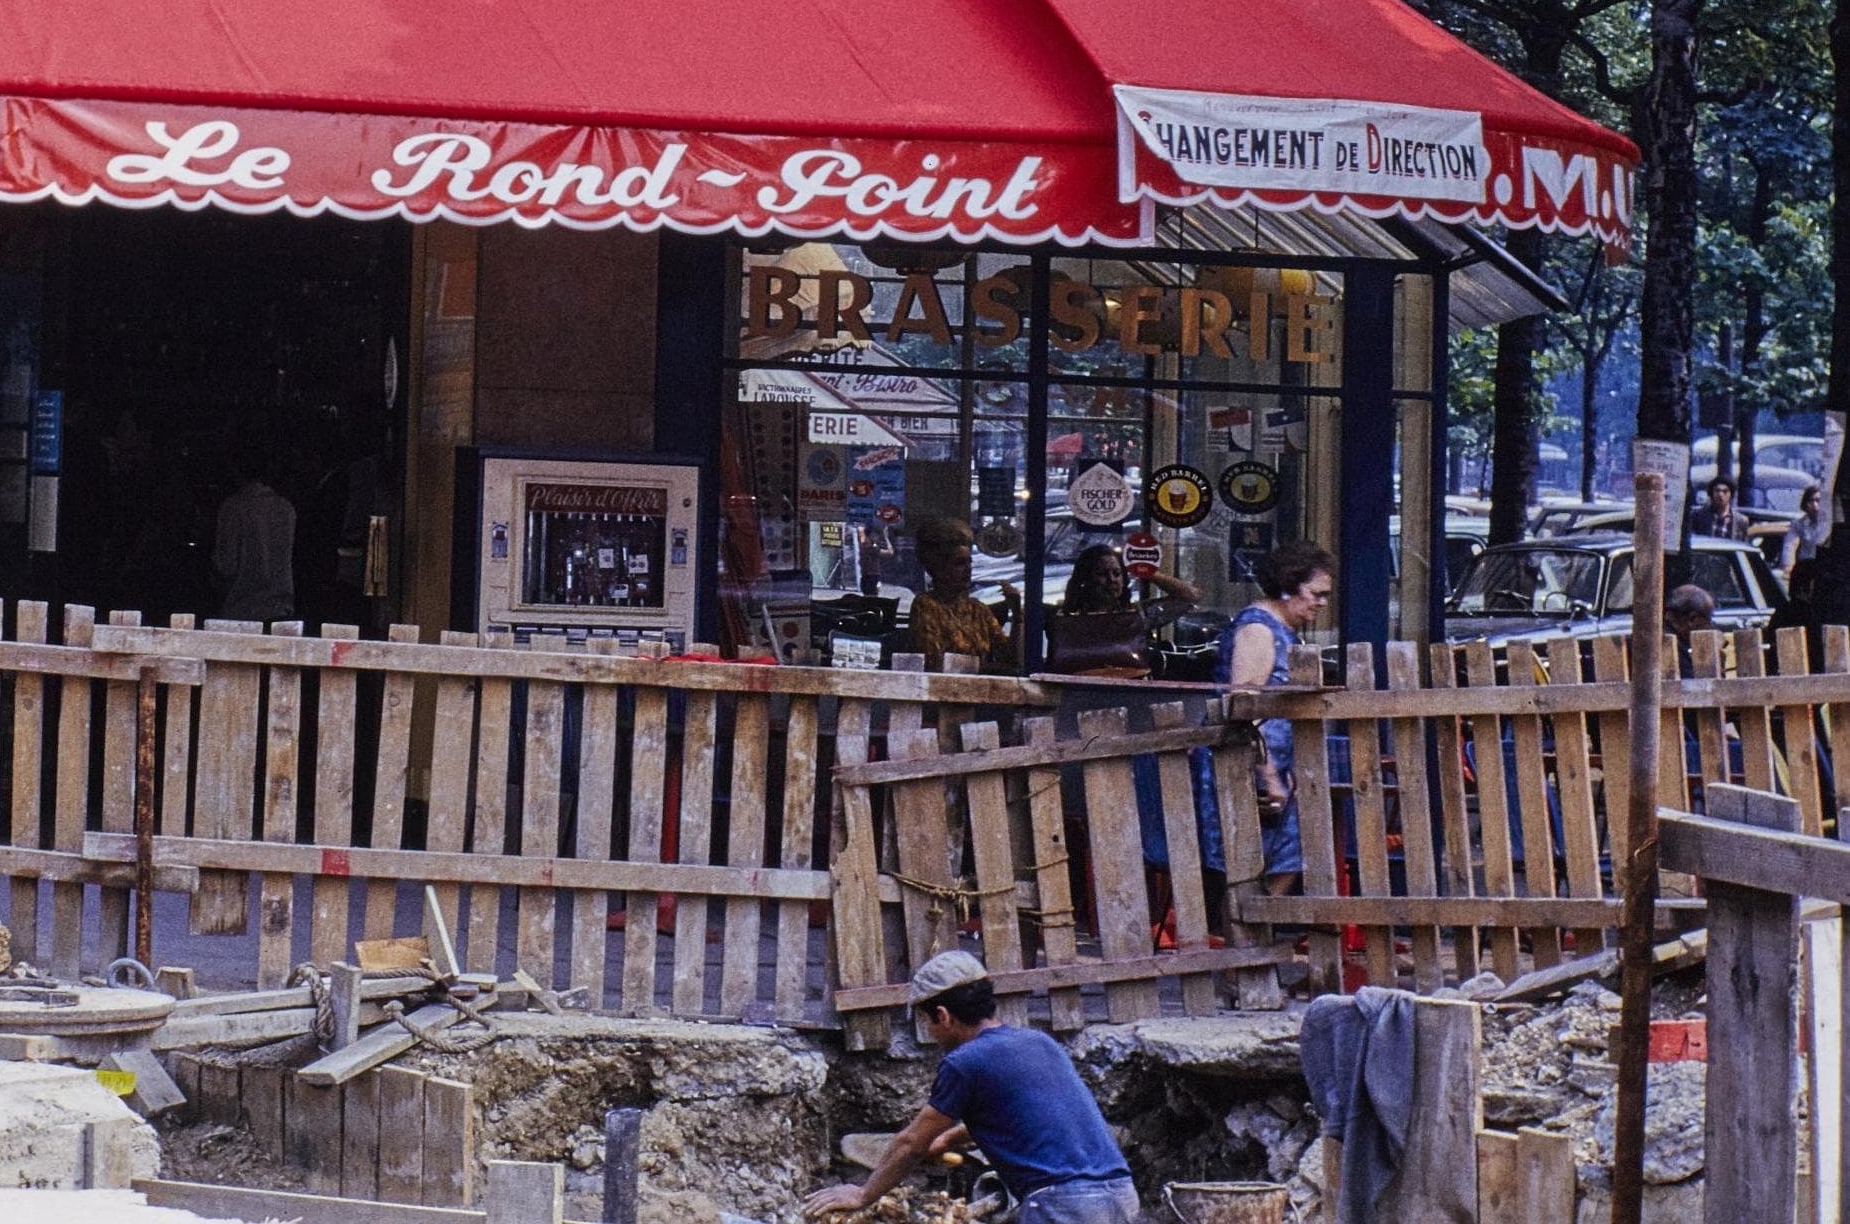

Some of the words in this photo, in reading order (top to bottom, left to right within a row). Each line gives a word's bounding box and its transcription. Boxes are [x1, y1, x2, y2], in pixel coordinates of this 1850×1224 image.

[105, 120, 290, 188] Le
[1366, 122, 1478, 181] DIRECTION
[749, 264, 1337, 366] BRASSERIE
[853, 373, 918, 394] Bistro
[530, 485, 592, 507] Plaisir
[1081, 489, 1123, 500] FISCHER
[1087, 499, 1116, 511] GOLD
